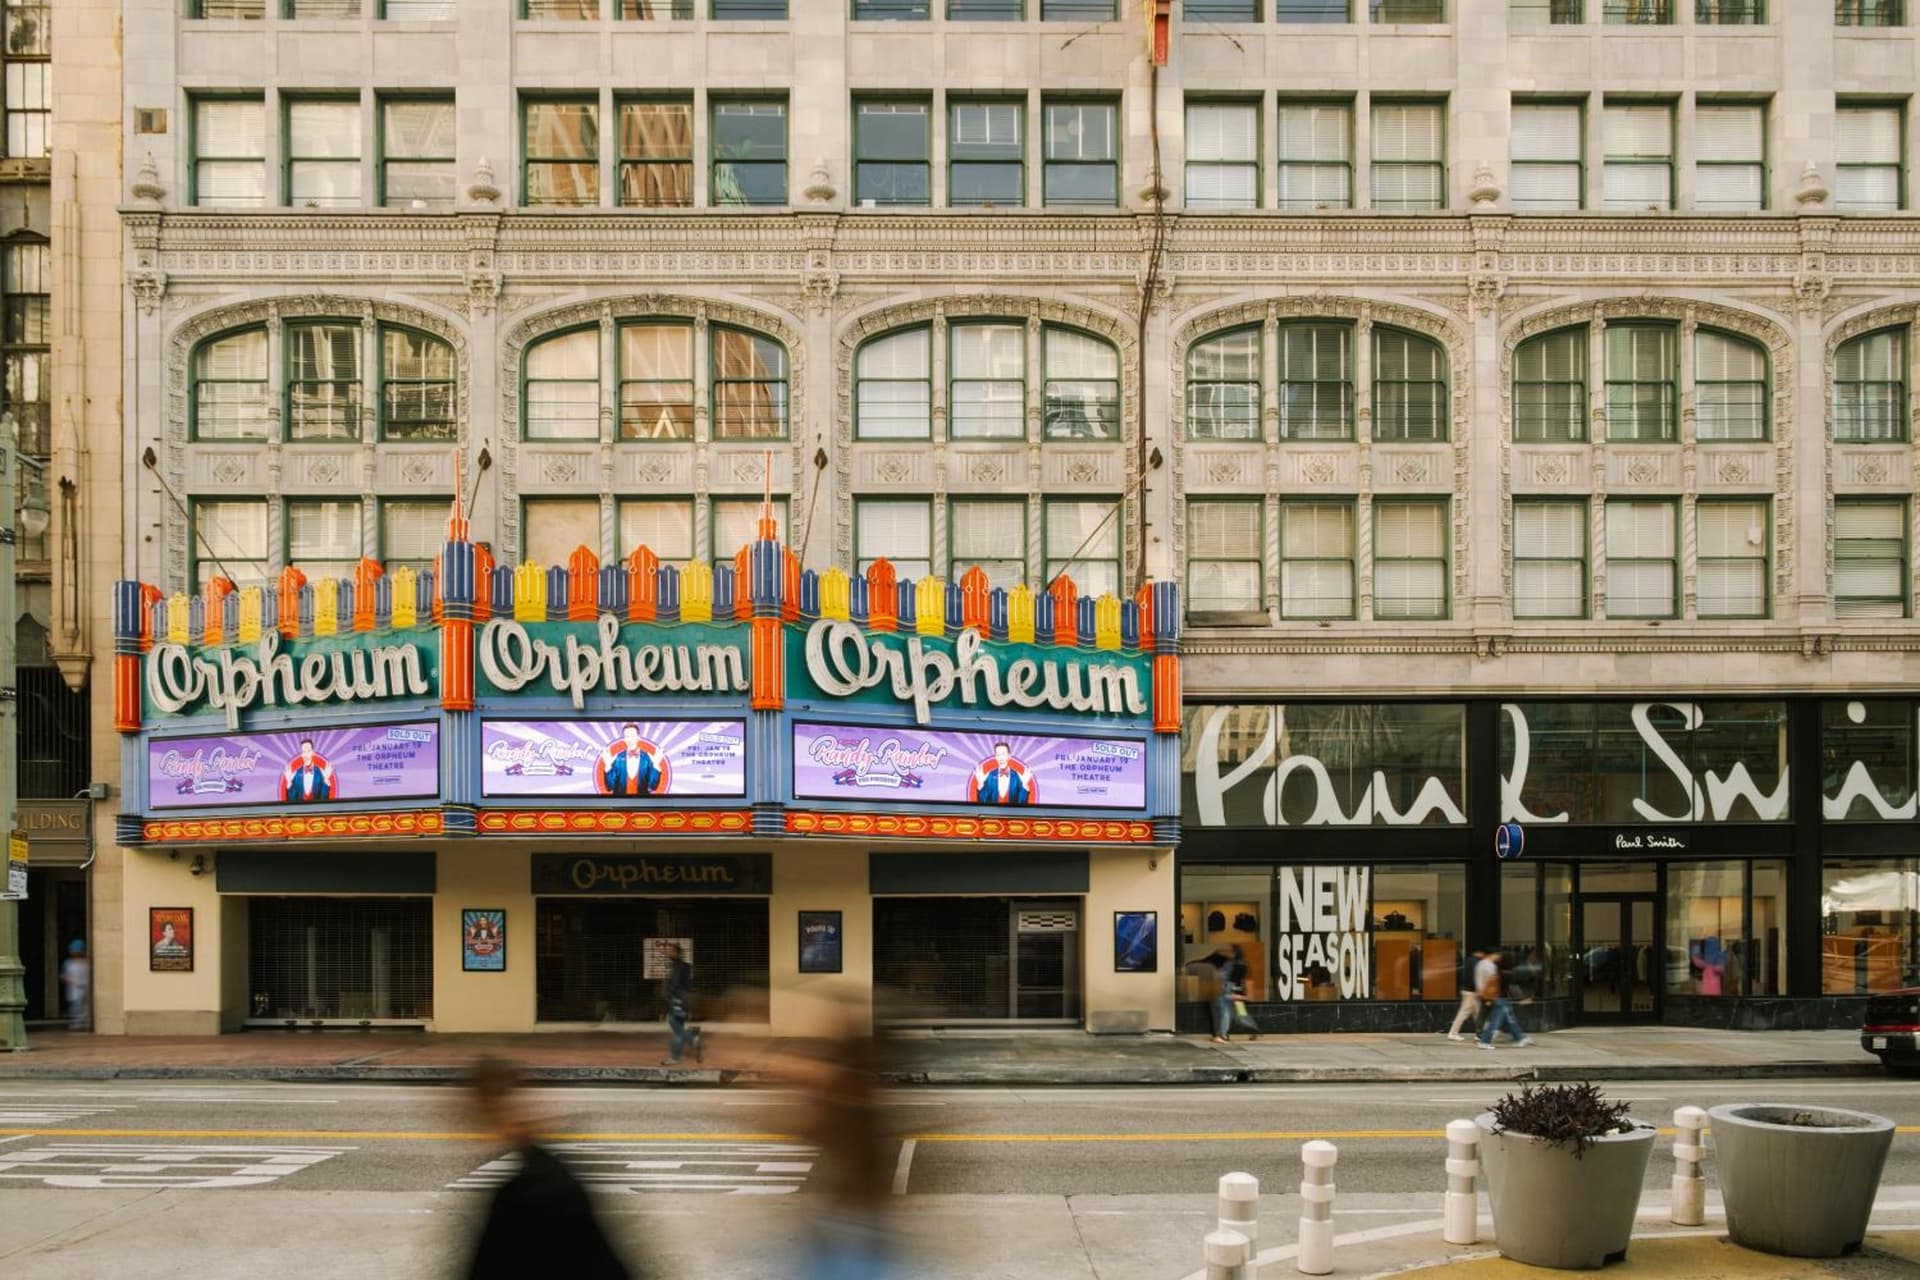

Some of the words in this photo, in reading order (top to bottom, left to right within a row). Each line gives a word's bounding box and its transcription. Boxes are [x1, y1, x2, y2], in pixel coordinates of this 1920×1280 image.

[480, 613, 749, 709] Orpheum
[146, 628, 429, 730] Orpheum
[805, 618, 1147, 724] Orpheum
[389, 730, 411, 738] SOLD
[412, 731, 430, 740] OUT
[374, 751, 416, 760] ORPHEUM
[1094, 742, 1118, 754] SOLD
[1119, 748, 1137, 758] OUT
[367, 762, 404, 770] THEATRE
[1076, 755, 1116, 764] JANUARY
[1195, 703, 1569, 826] Paul
[1631, 702, 1920, 822] Smi
[1060, 763, 1076, 771] THE
[1079, 764, 1123, 773] ORPHEUM
[1071, 773, 1111, 782] THEATRE
[24, 813, 80, 830] ILDING
[1616, 834, 1643, 848] Paul
[1647, 835, 1685, 848] Smith
[572, 859, 733, 888] Orpheum
[1280, 866, 1369, 932] NEW
[1279, 933, 1369, 1001] SEASON
